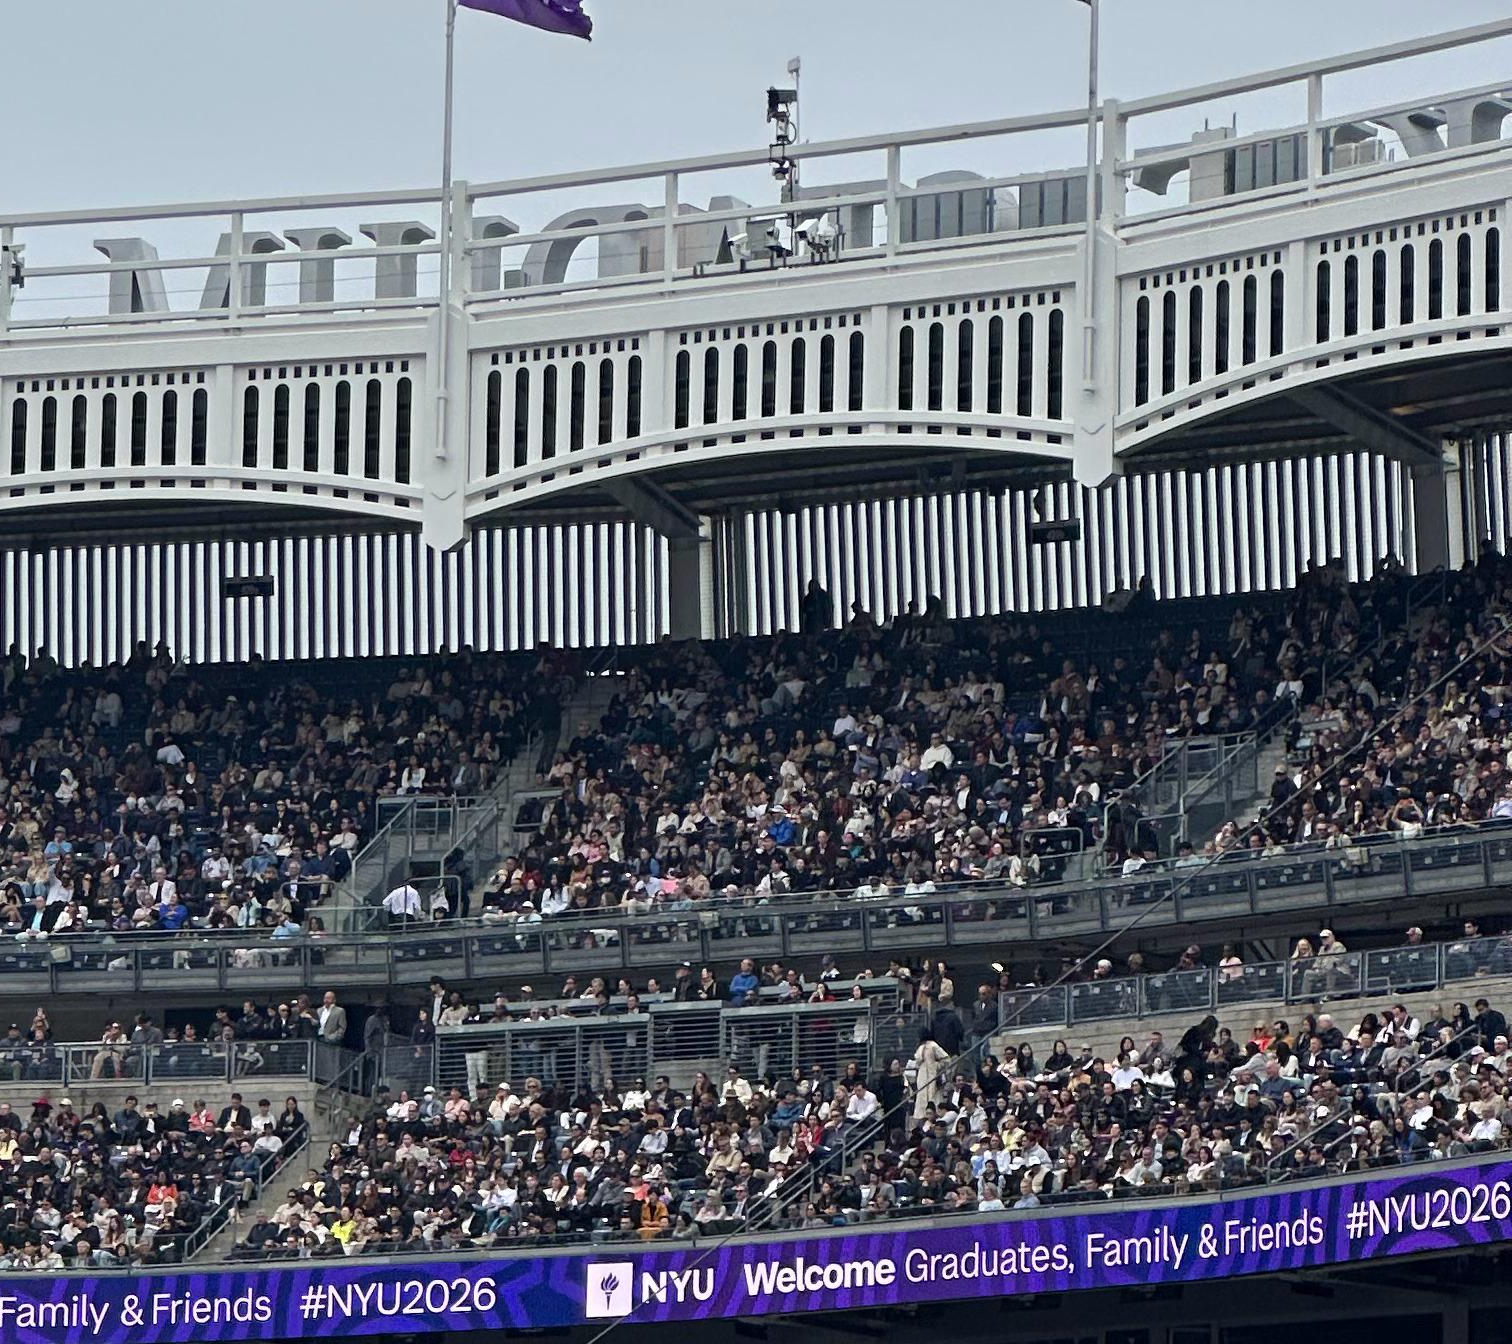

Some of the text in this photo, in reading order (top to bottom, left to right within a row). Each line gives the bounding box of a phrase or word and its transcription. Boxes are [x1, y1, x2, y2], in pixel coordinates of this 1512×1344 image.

[641, 1181, 1512, 1304] NYU Welcome Graduates, Family & Friends #NYU2026
[120, 1294, 144, 1326] &
[153, 1287, 271, 1325] Friends
[299, 1277, 496, 1319] #NYU2026
